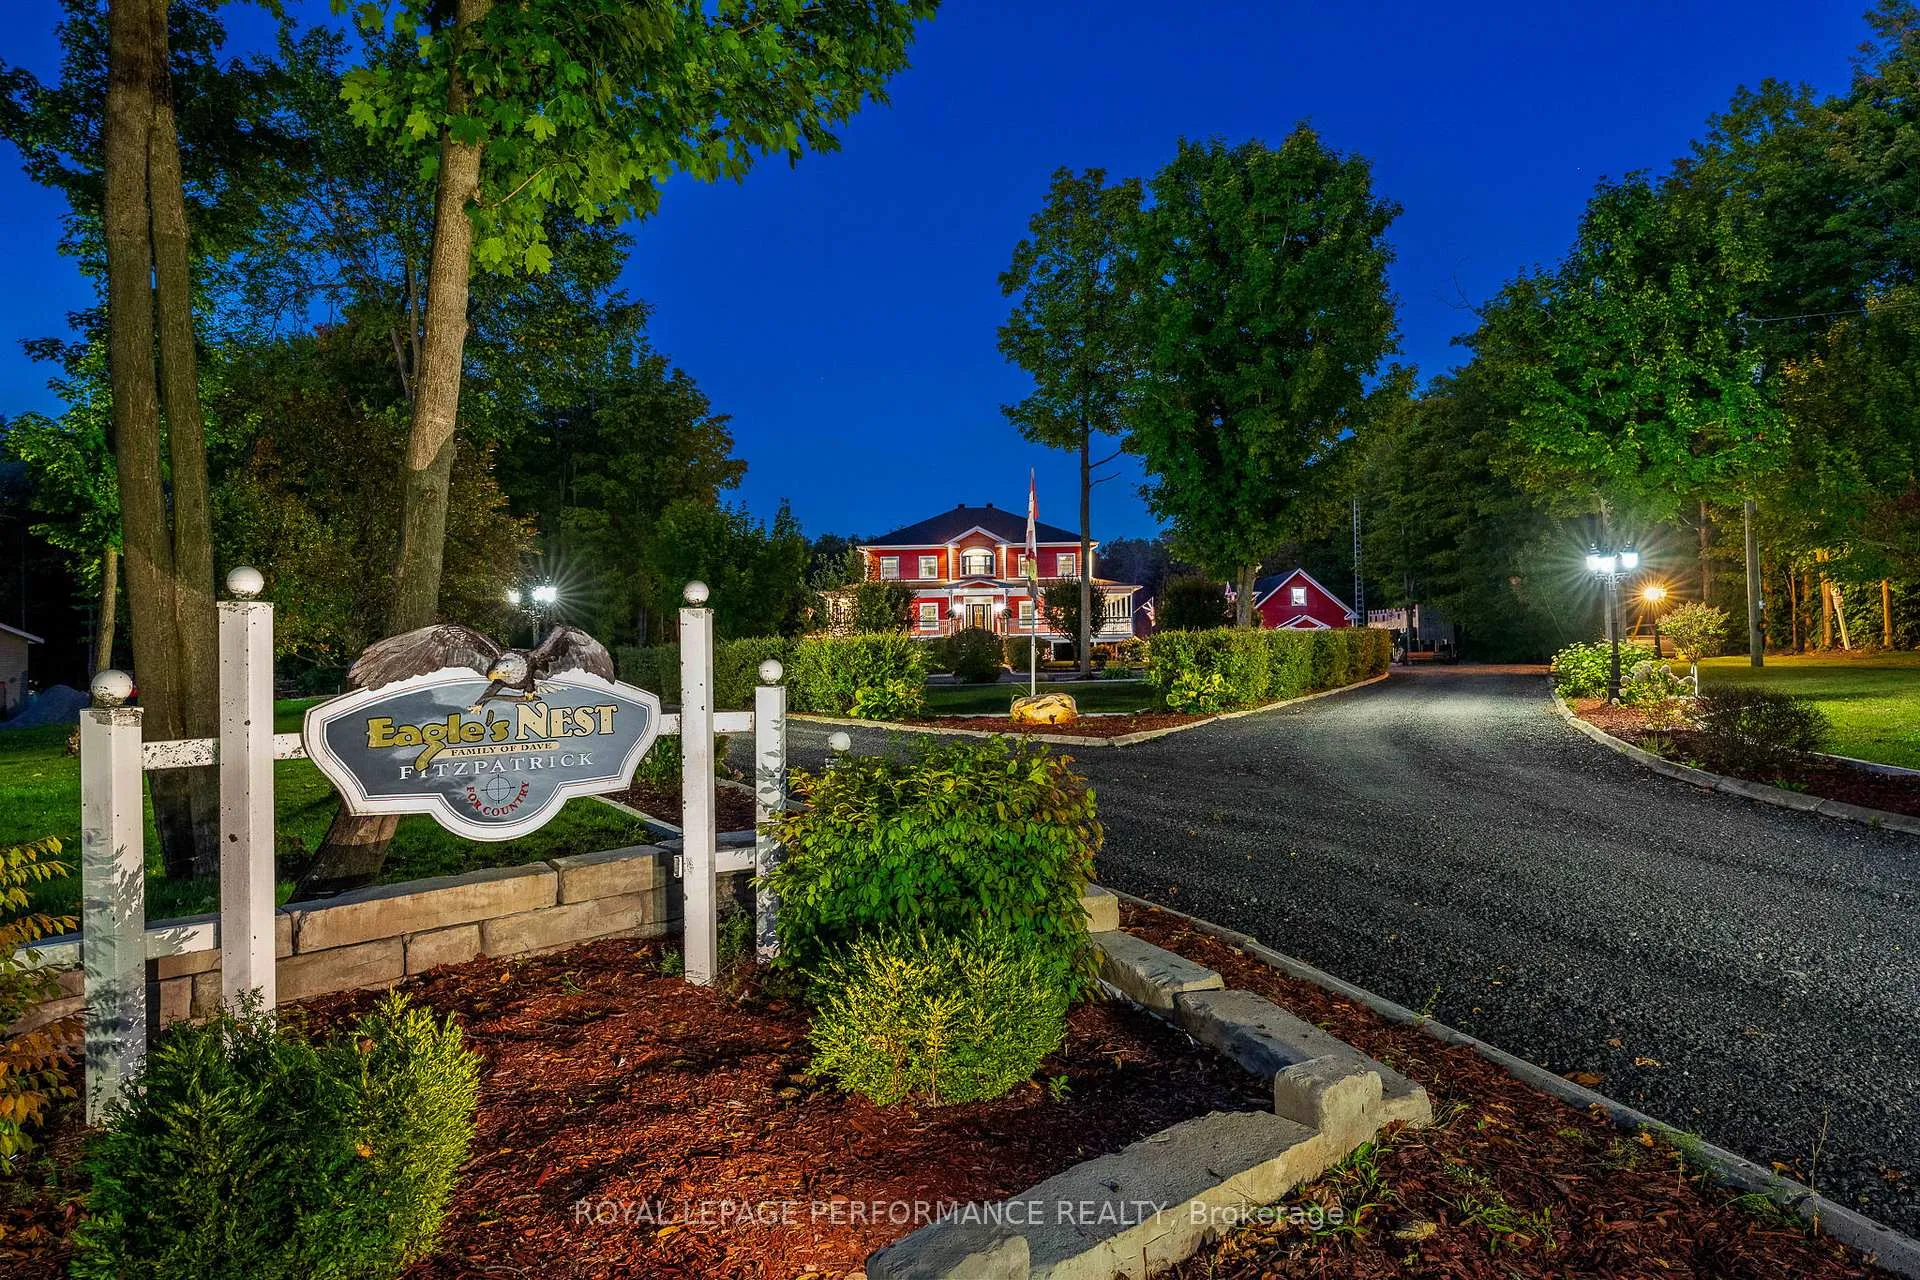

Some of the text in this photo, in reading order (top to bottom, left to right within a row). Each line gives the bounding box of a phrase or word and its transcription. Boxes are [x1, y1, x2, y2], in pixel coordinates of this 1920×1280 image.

[367, 702, 619, 772] Eagle's NEST
[451, 742, 552, 757] FAMILY OF DAVE
[399, 752, 594, 781] FITZPATRICK
[466, 780, 530, 817] FOR COUNTRY
